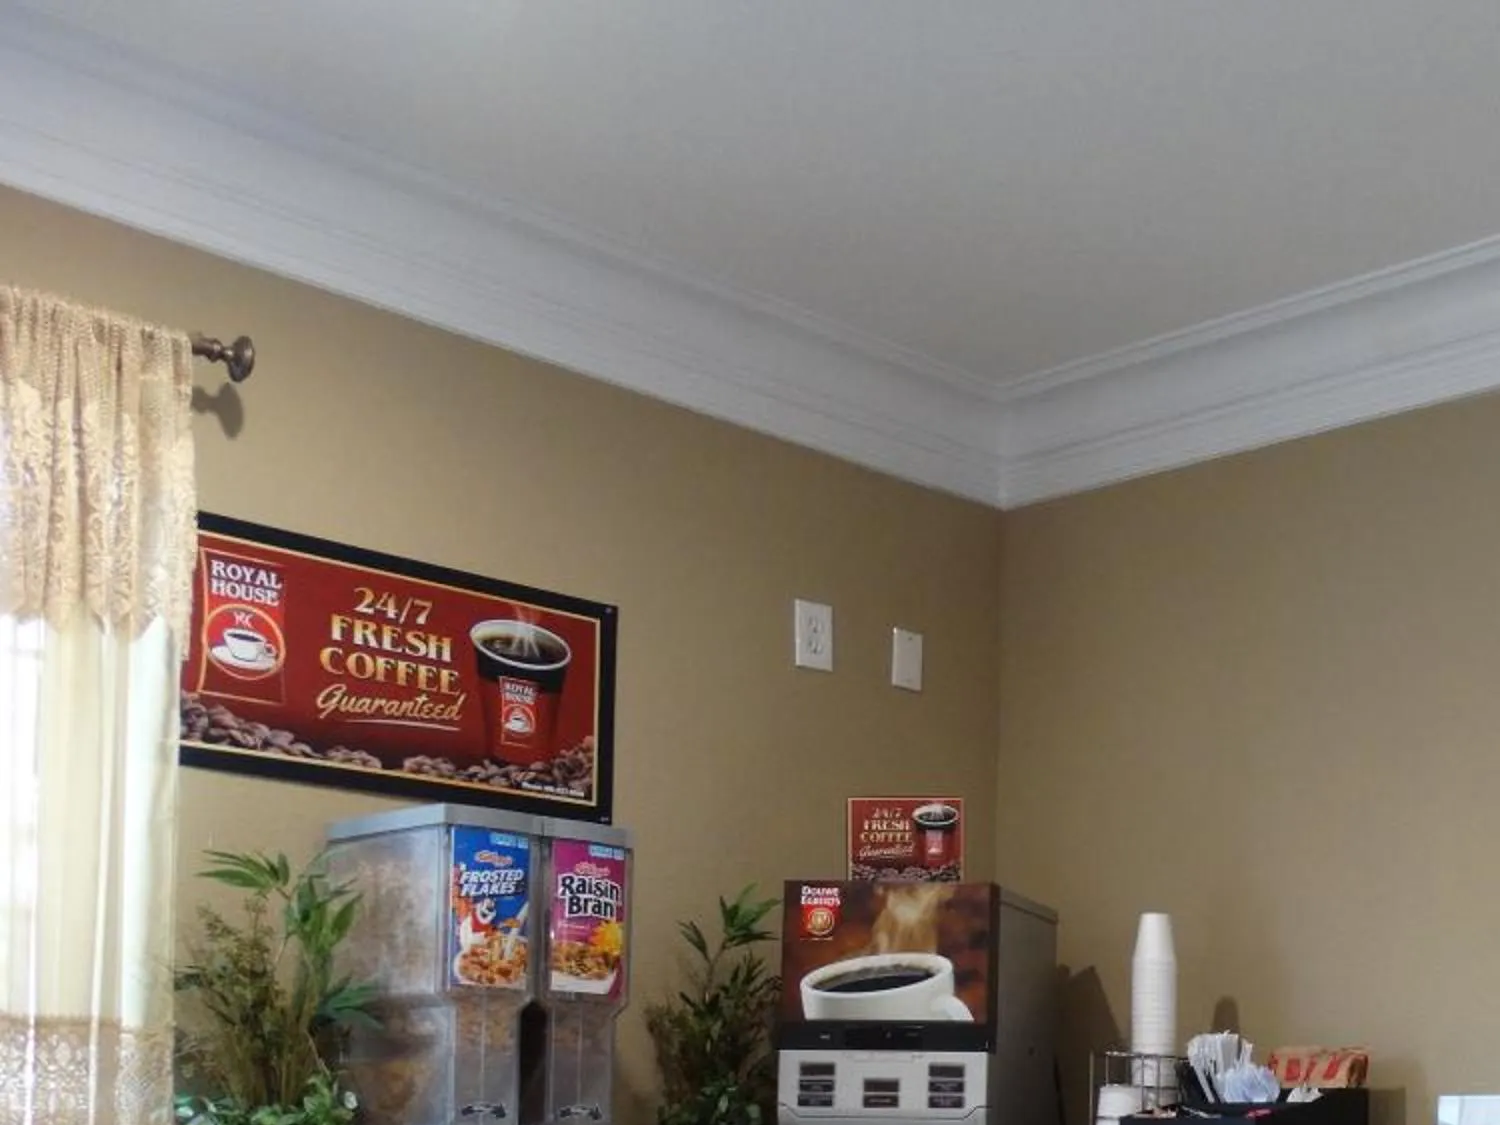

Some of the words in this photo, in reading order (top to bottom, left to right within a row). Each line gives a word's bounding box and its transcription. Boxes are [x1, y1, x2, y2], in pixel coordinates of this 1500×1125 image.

[211, 559, 283, 589] ROYAL
[211, 578, 280, 607] HOUSE
[353, 586, 433, 625] 24/7
[331, 613, 453, 662] FRESH
[319, 646, 461, 696] COFFEE
[316, 683, 467, 720] Guaranteed
[863, 819, 910, 831] FRESH
[461, 869, 524, 884] FROSTED
[461, 881, 517, 897] FLAKES
[559, 874, 621, 903] Raisin
[567, 895, 616, 918] Bran
